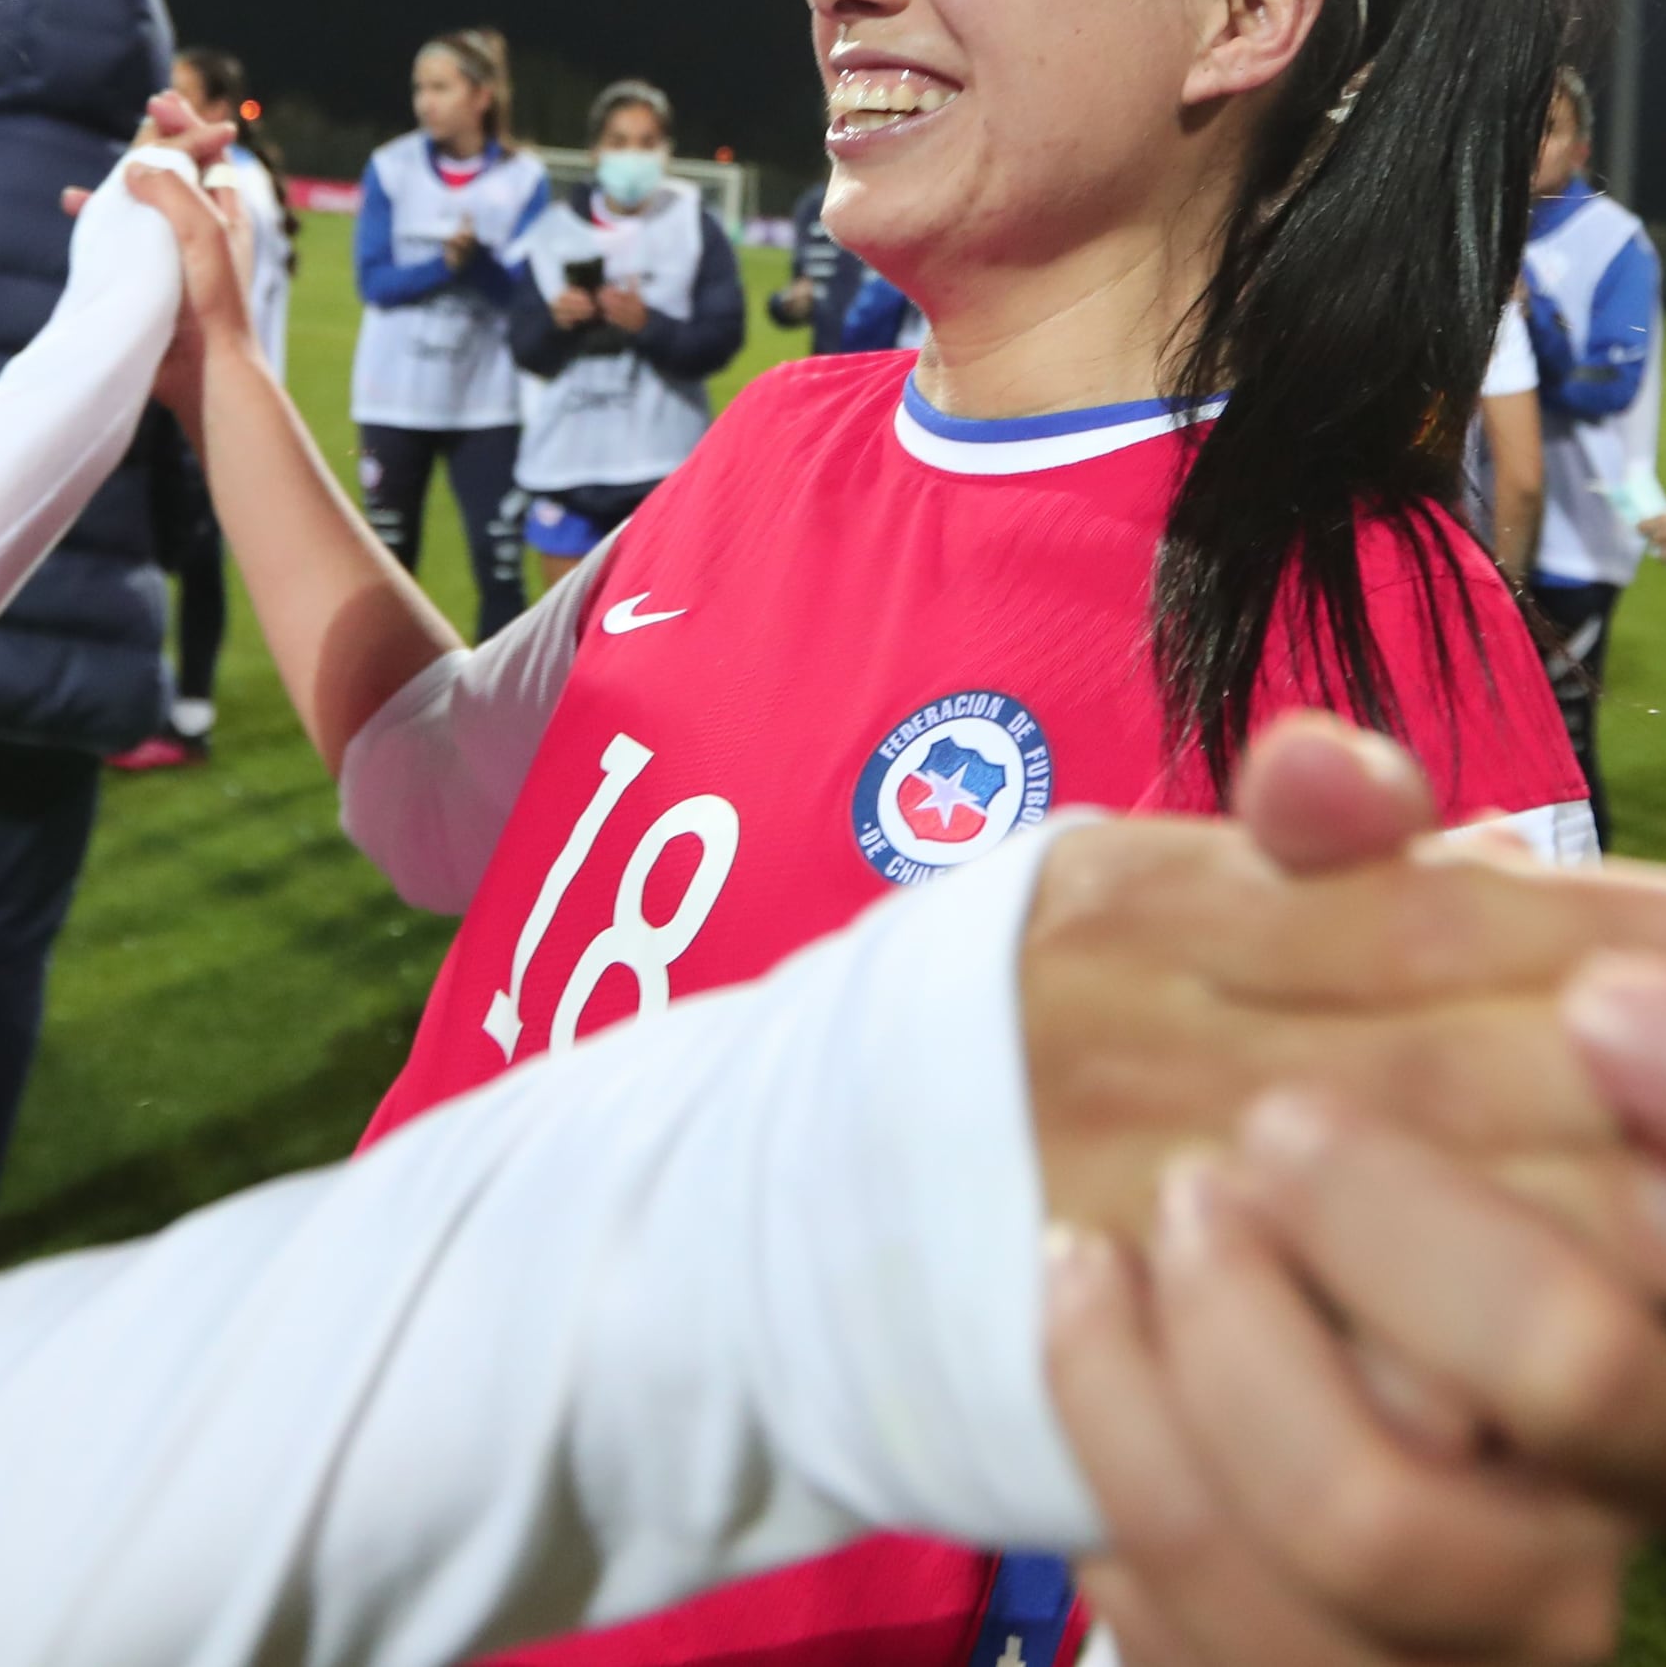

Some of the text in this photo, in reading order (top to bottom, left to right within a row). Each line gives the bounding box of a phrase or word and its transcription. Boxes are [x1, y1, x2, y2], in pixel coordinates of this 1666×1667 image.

[877, 693, 1006, 761] FEDERACION
[1006, 710, 1037, 744] DE
[858, 827, 889, 861] DE
[481, 732, 741, 1065] 18
